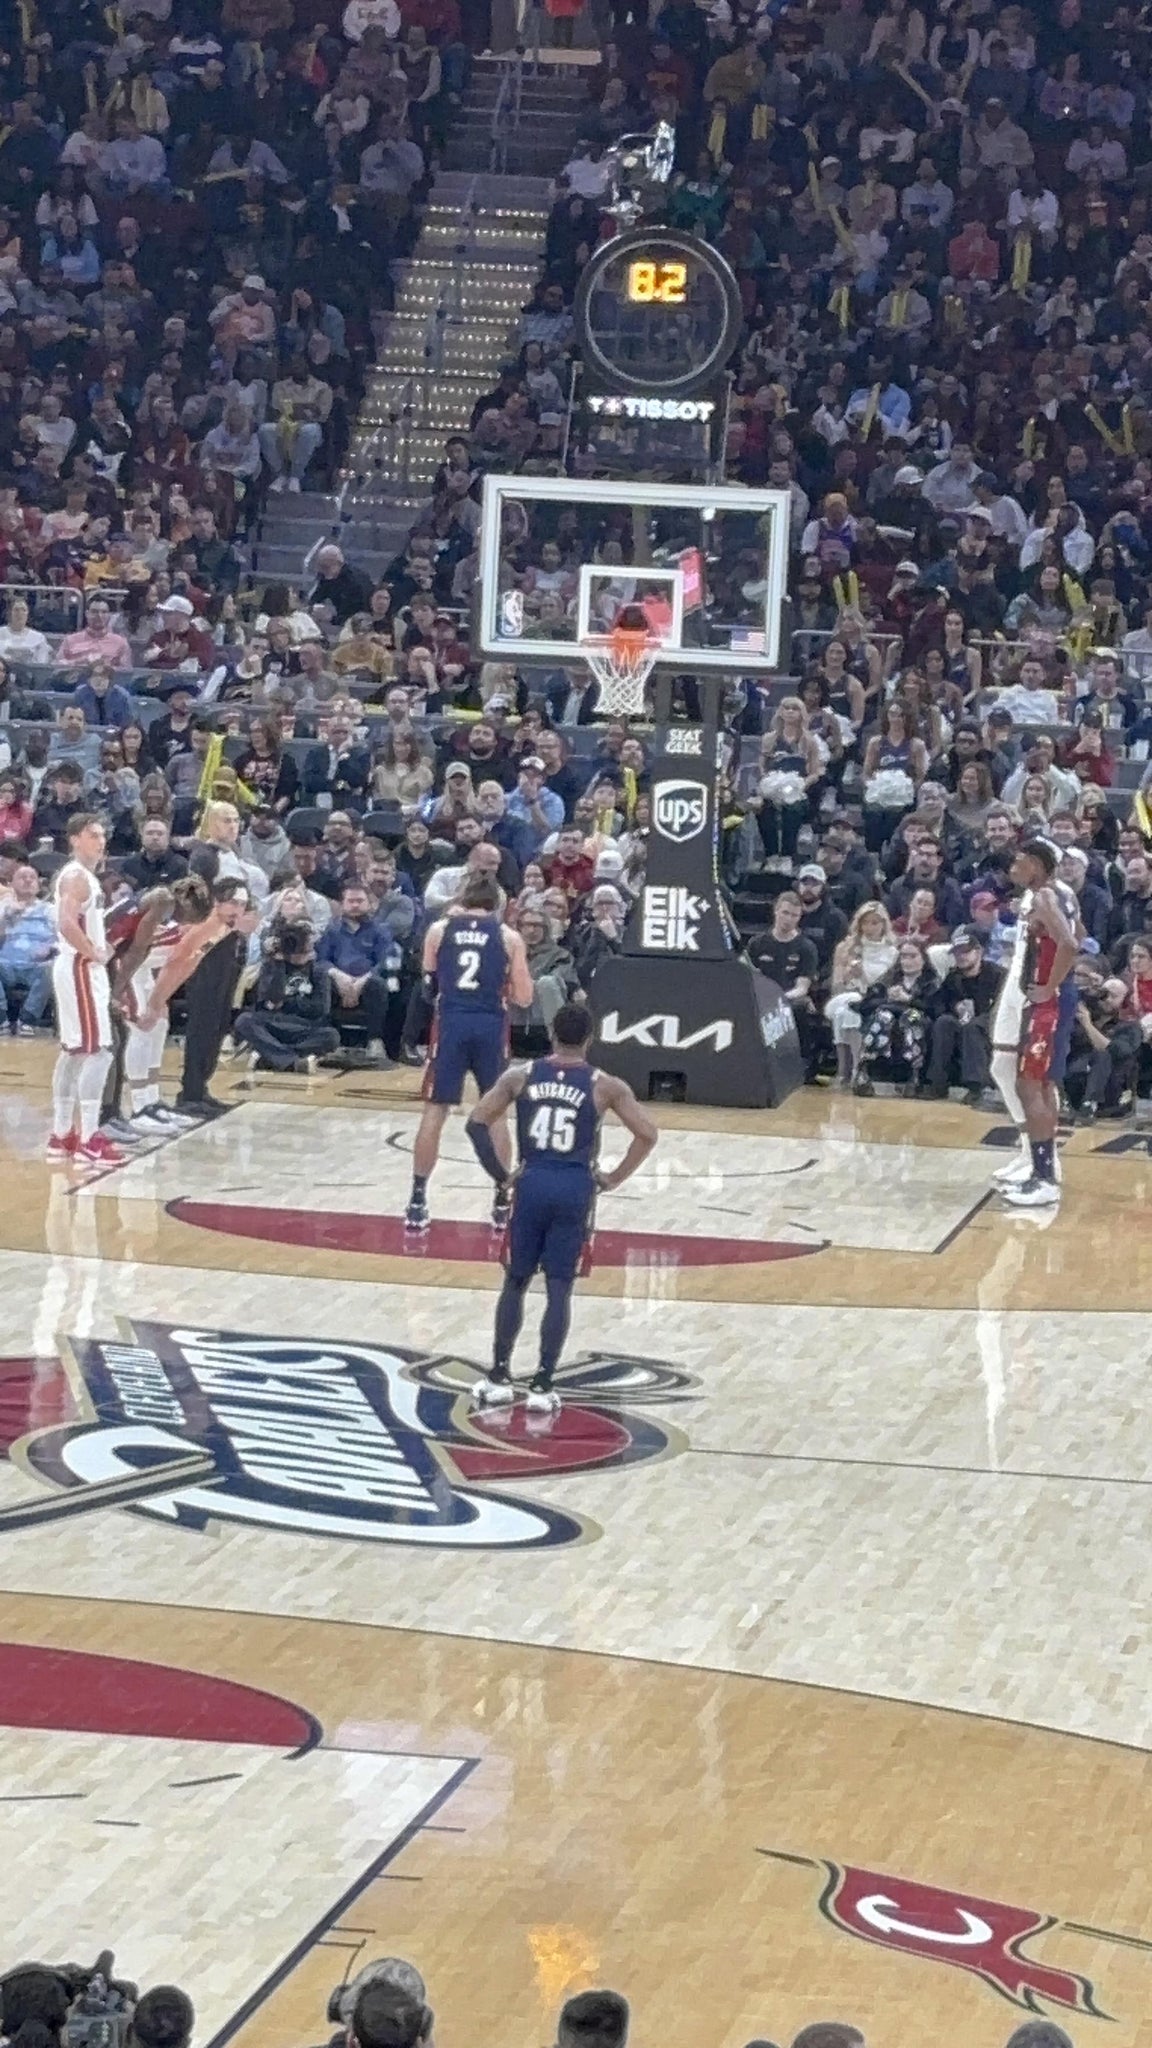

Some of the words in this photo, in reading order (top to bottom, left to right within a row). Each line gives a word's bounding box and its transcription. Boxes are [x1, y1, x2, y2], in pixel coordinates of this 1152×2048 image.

[622, 398, 715, 422] TISSOT
[659, 799, 703, 832] ups
[645, 886, 700, 920] Elk
[641, 918, 700, 951] Elk
[458, 950, 480, 989] 2
[601, 1010, 733, 1052] KIA
[530, 1105, 577, 1152] 45
[99, 1344, 187, 1425] CLEVELAND
[62, 1330, 550, 1544] CAVALIERS
